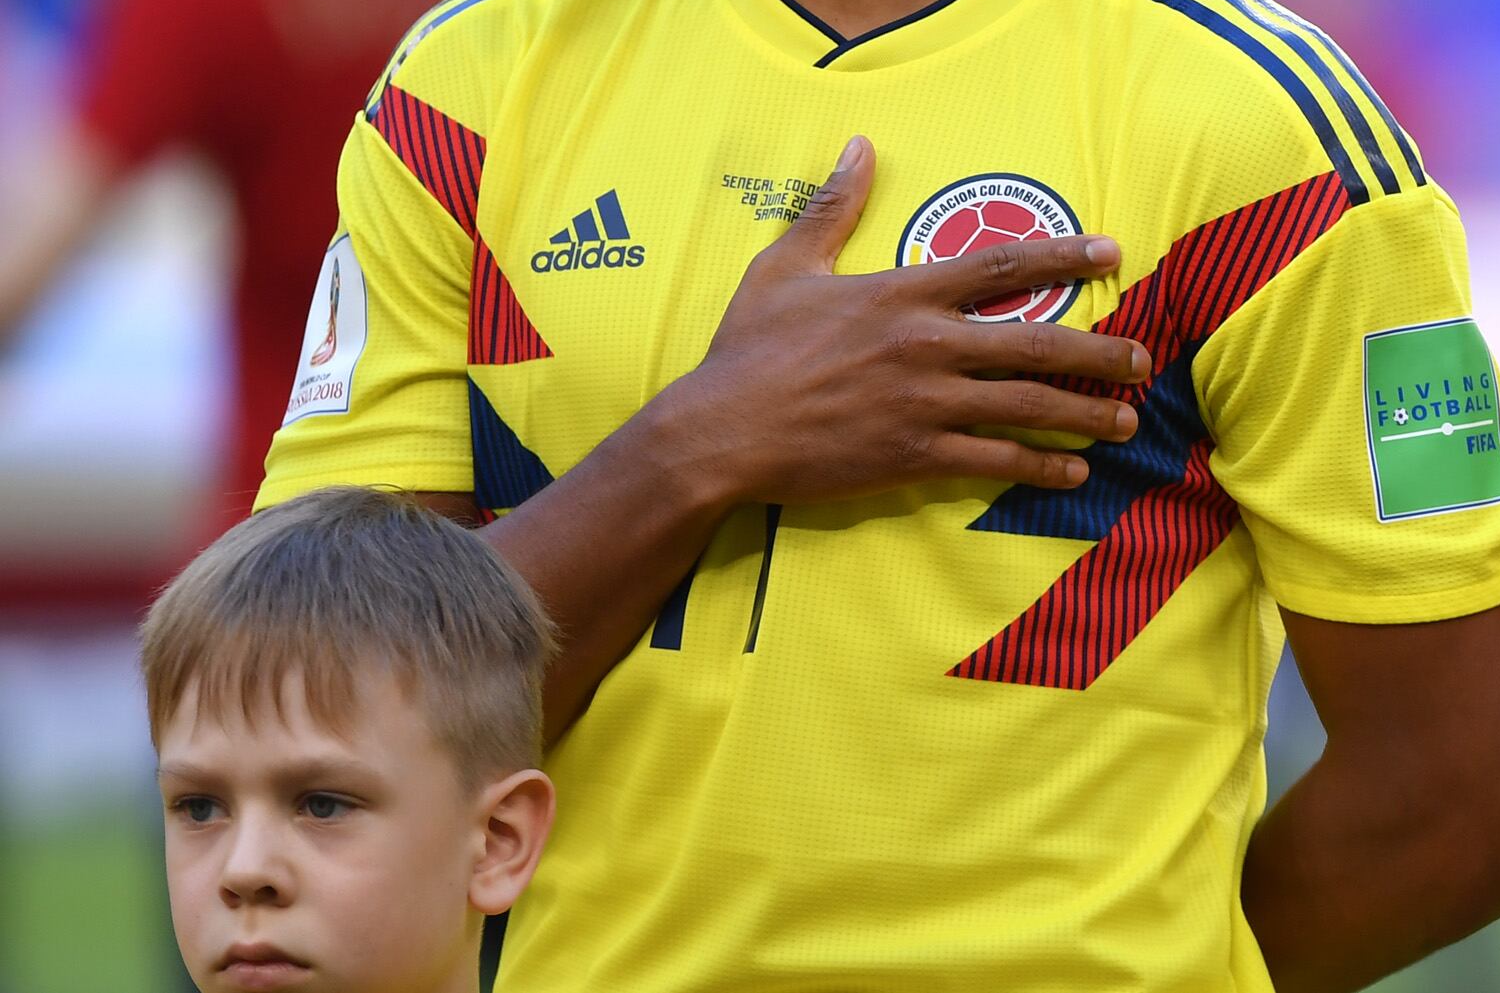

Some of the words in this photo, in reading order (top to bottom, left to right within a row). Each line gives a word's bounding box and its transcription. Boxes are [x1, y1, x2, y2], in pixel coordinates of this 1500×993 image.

[721, 174, 774, 192] SENEGAL
[741, 192, 758, 206] 28
[760, 192, 788, 207] JUNE
[791, 194, 808, 211] 20
[914, 188, 977, 243] FEDERACION
[980, 184, 1058, 222] COLOMBIANA
[1052, 219, 1068, 237] DE
[530, 240, 646, 273] adidas
[313, 381, 343, 400] 2018
[1375, 373, 1490, 406] LIVING
[1466, 432, 1497, 454] FIFA
